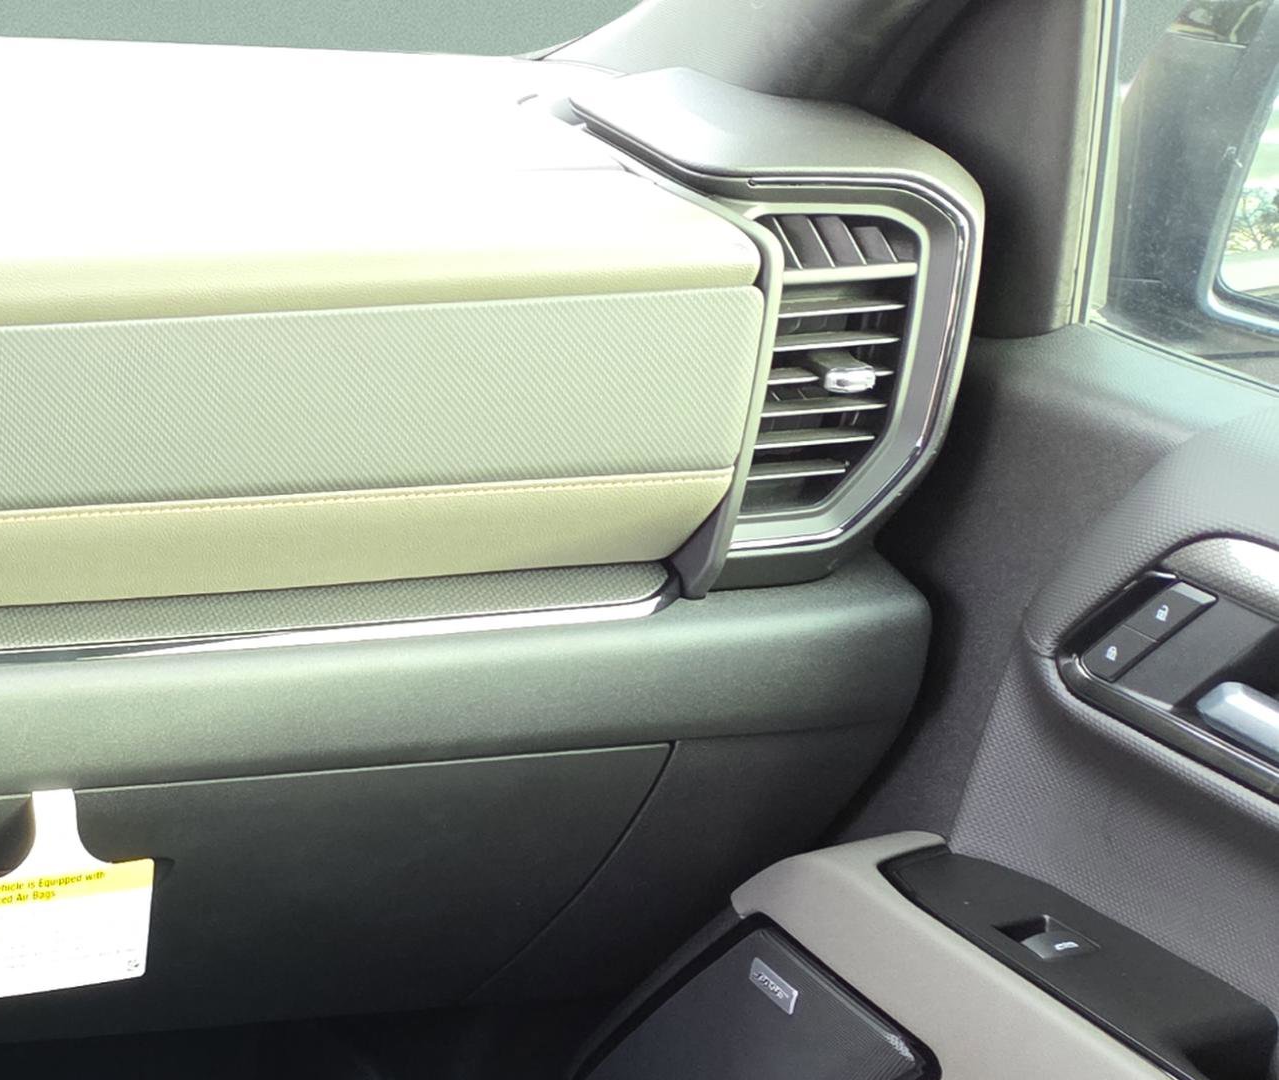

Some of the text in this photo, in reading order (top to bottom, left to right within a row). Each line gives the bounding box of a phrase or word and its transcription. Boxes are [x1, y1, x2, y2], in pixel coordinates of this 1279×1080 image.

[37, 874, 83, 888] Equipped
[85, 870, 105, 880] with
[16, 893, 29, 902] Air
[32, 889, 56, 901] Bags
